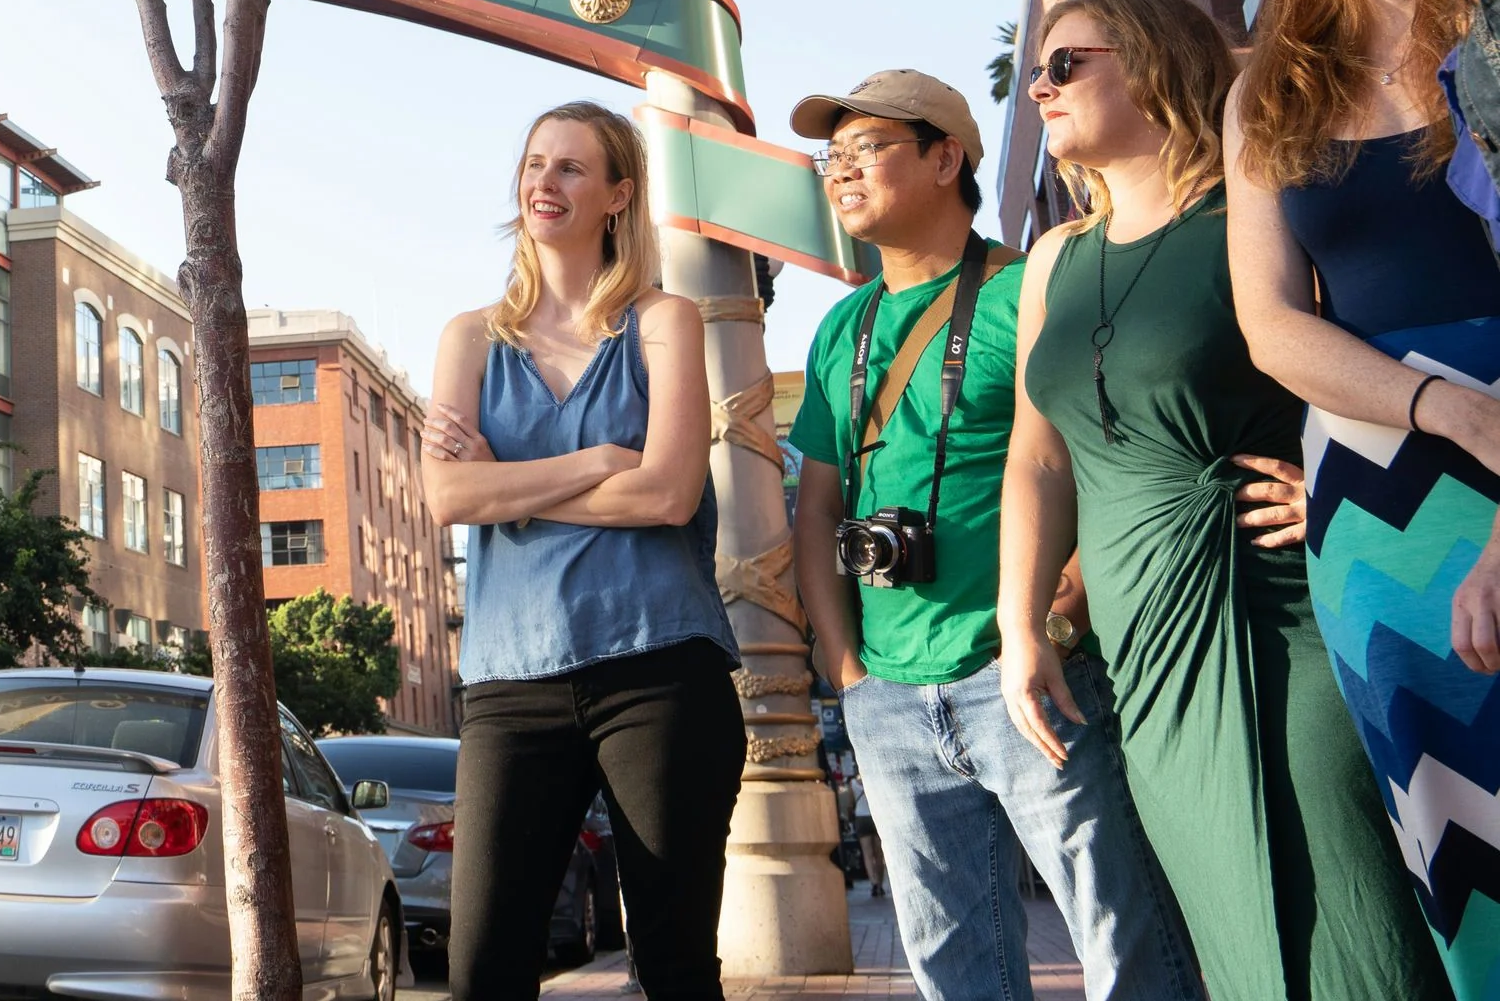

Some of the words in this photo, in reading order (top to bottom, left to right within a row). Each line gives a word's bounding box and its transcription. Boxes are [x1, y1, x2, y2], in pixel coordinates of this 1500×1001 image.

[857, 333, 868, 365] SONY
[71, 782, 123, 792] COROLLA
[124, 783, 140, 793] S
